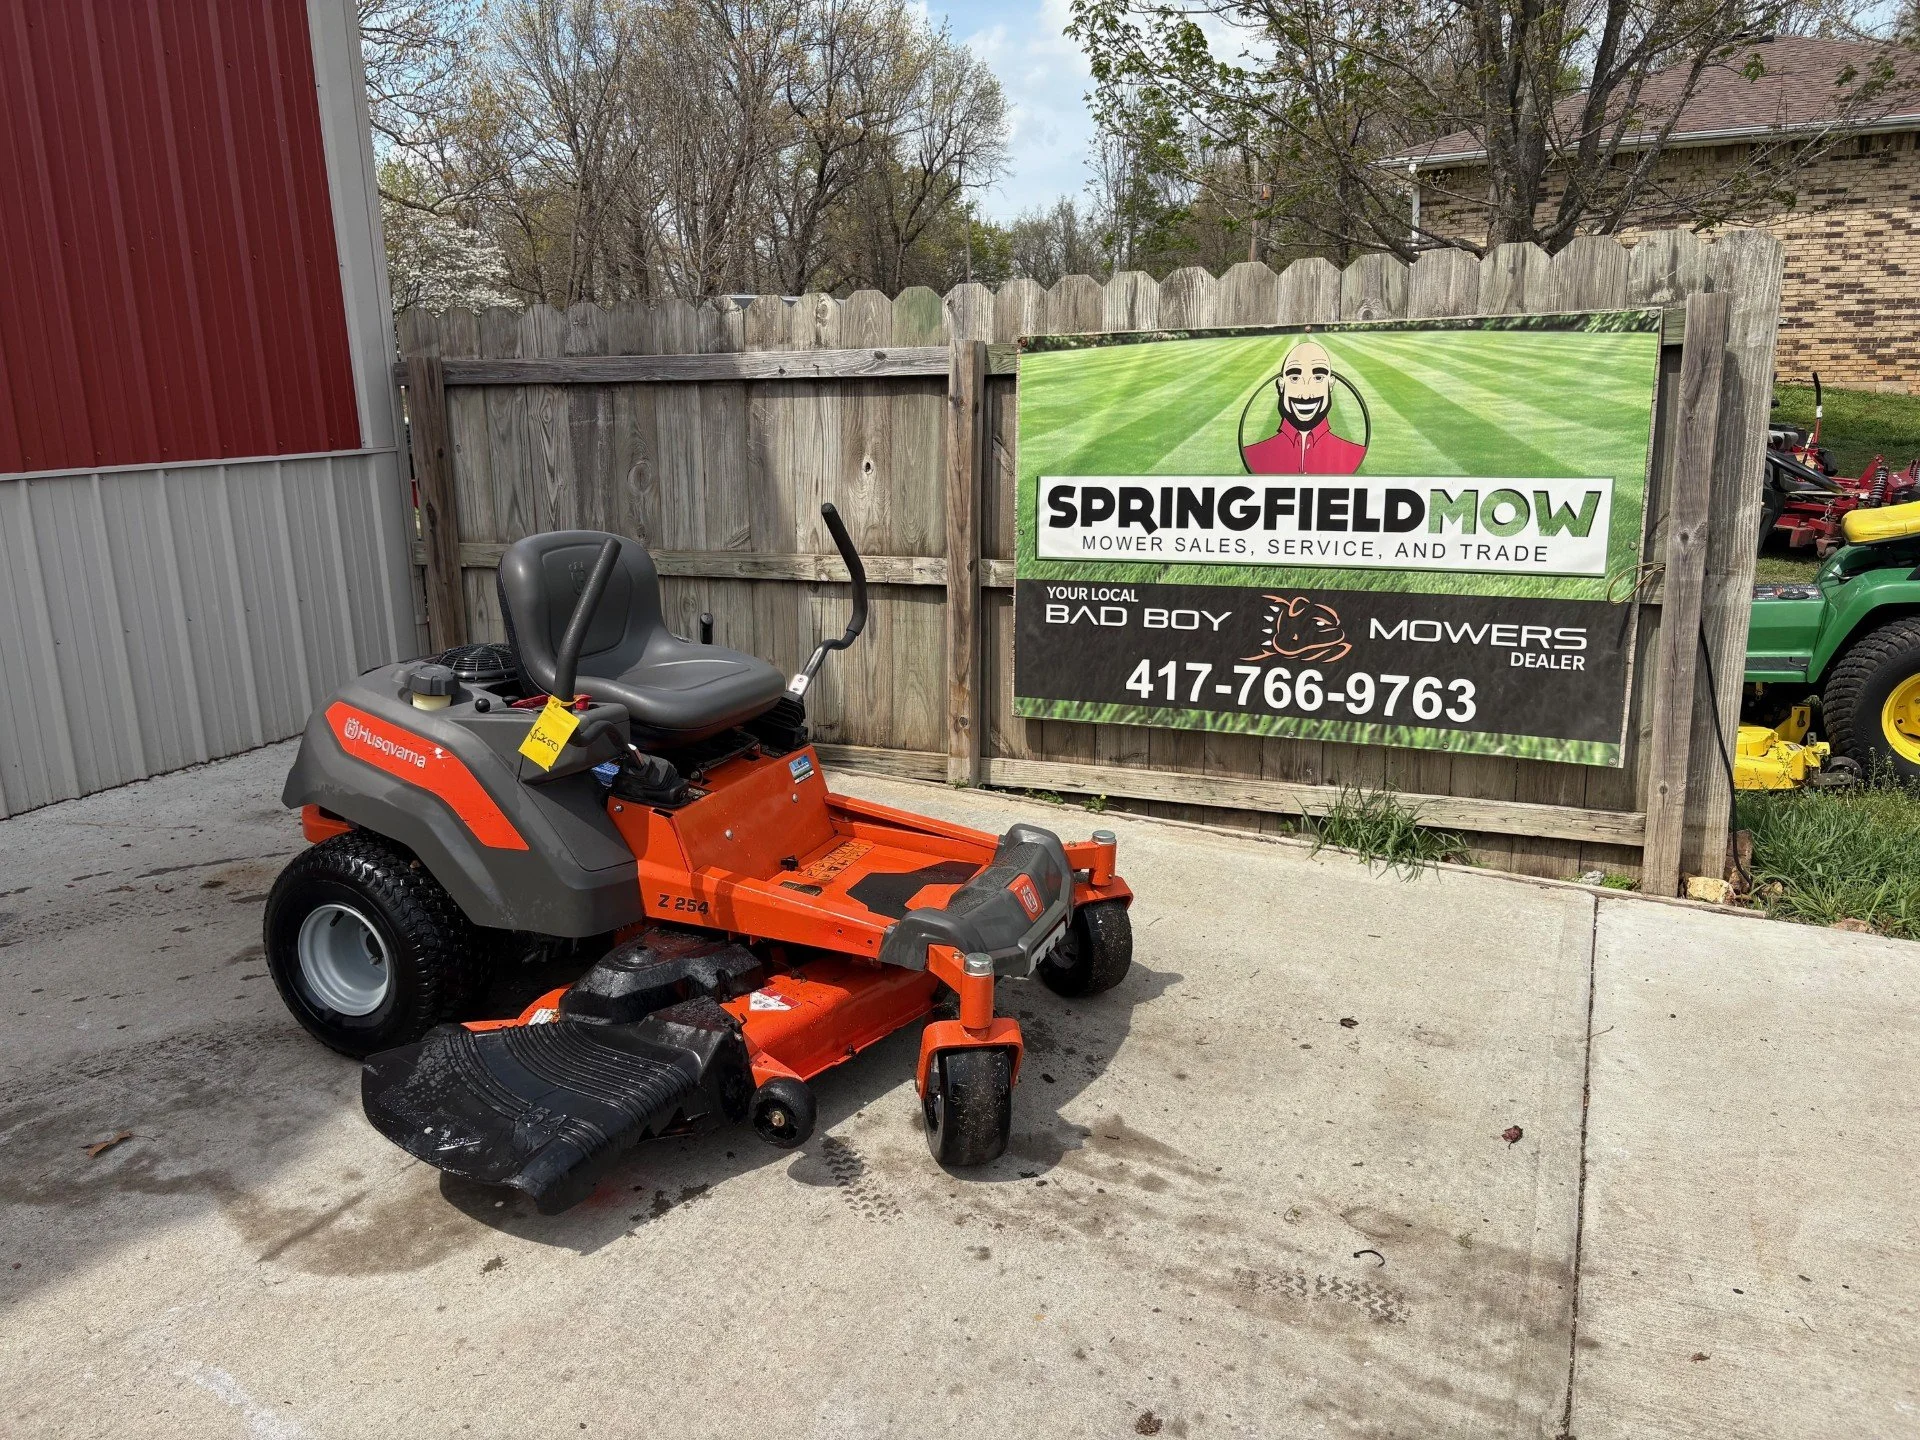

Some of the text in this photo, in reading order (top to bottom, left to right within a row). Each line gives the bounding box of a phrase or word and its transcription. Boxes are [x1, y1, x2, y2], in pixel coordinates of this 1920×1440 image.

[1082, 535, 1548, 562] MOWER SALES, SERVICE, AND TRADE
[1046, 586, 1139, 603] YOUR LOCAL
[1045, 603, 1588, 650] BAD BOY MOWERS
[1510, 652, 1586, 671] DEALER
[1125, 658, 1477, 724] 417-766-9763
[358, 724, 427, 769] Husqvarna
[657, 893, 709, 915] Z 254
